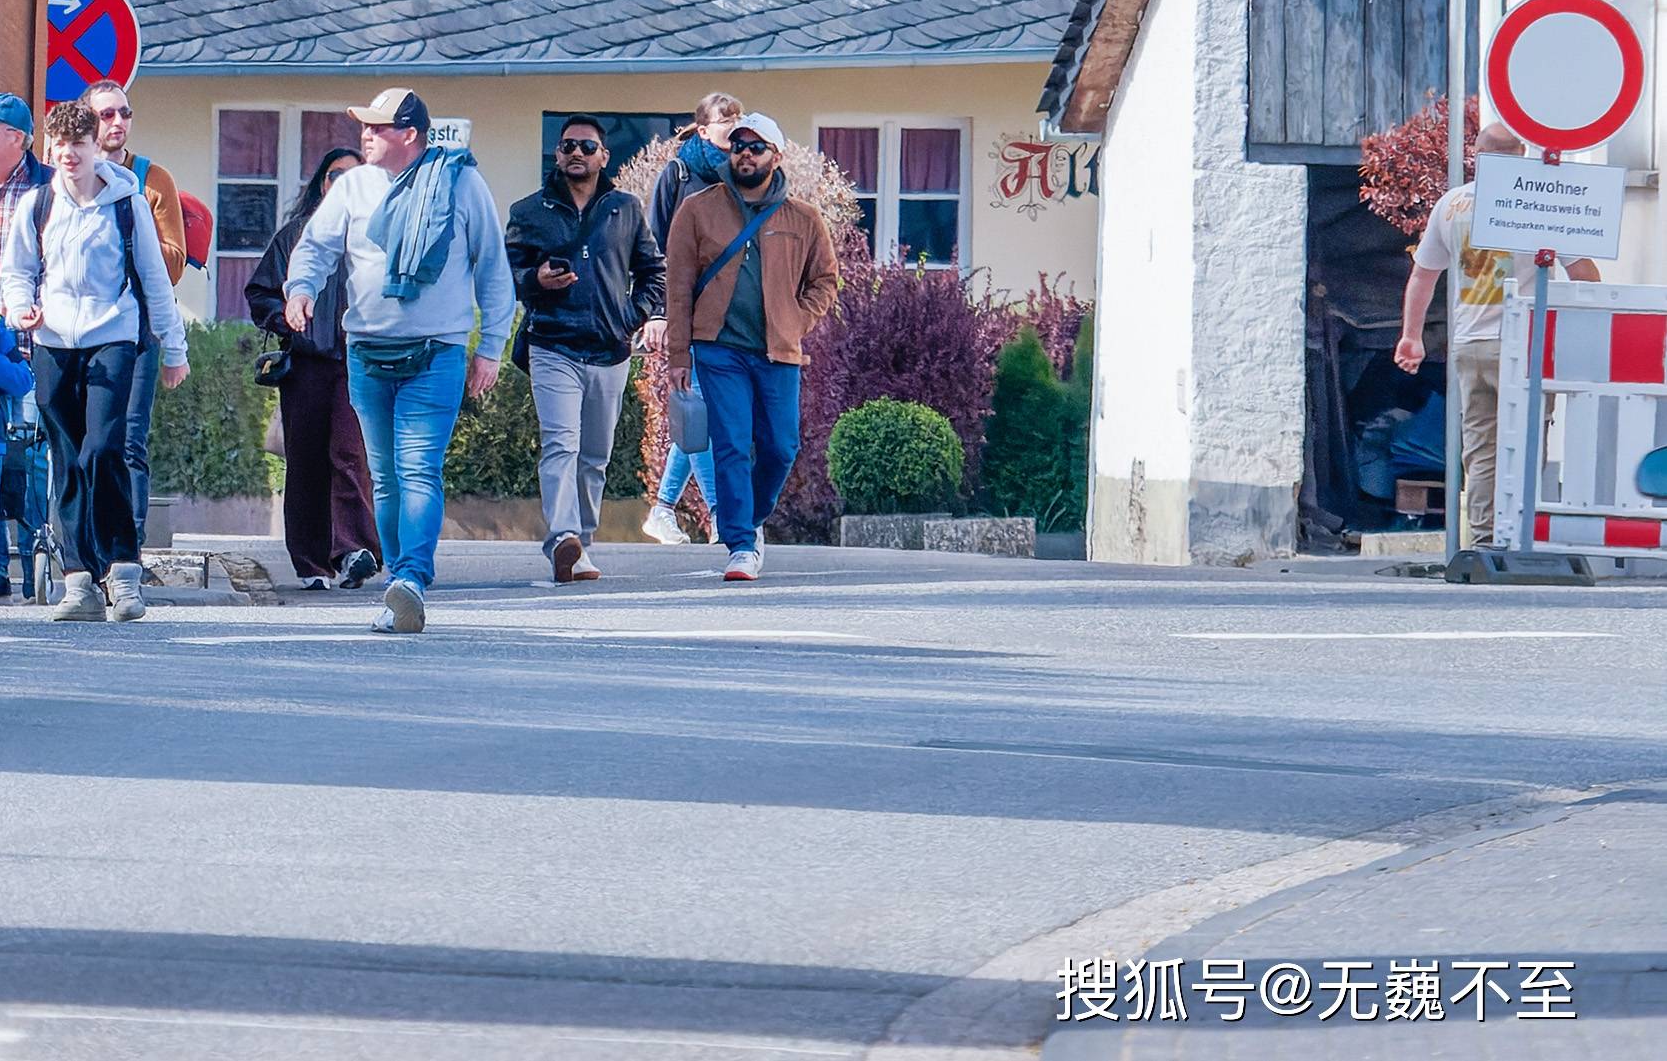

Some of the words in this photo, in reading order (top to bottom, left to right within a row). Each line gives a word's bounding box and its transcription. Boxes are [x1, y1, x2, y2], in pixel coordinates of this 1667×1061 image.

[1513, 176, 1588, 196] Anwohner
[1495, 198, 1512, 209] mit
[1515, 198, 1581, 216] Parkausweis
[1585, 204, 1601, 217] frei
[1547, 224, 1564, 233] wird
